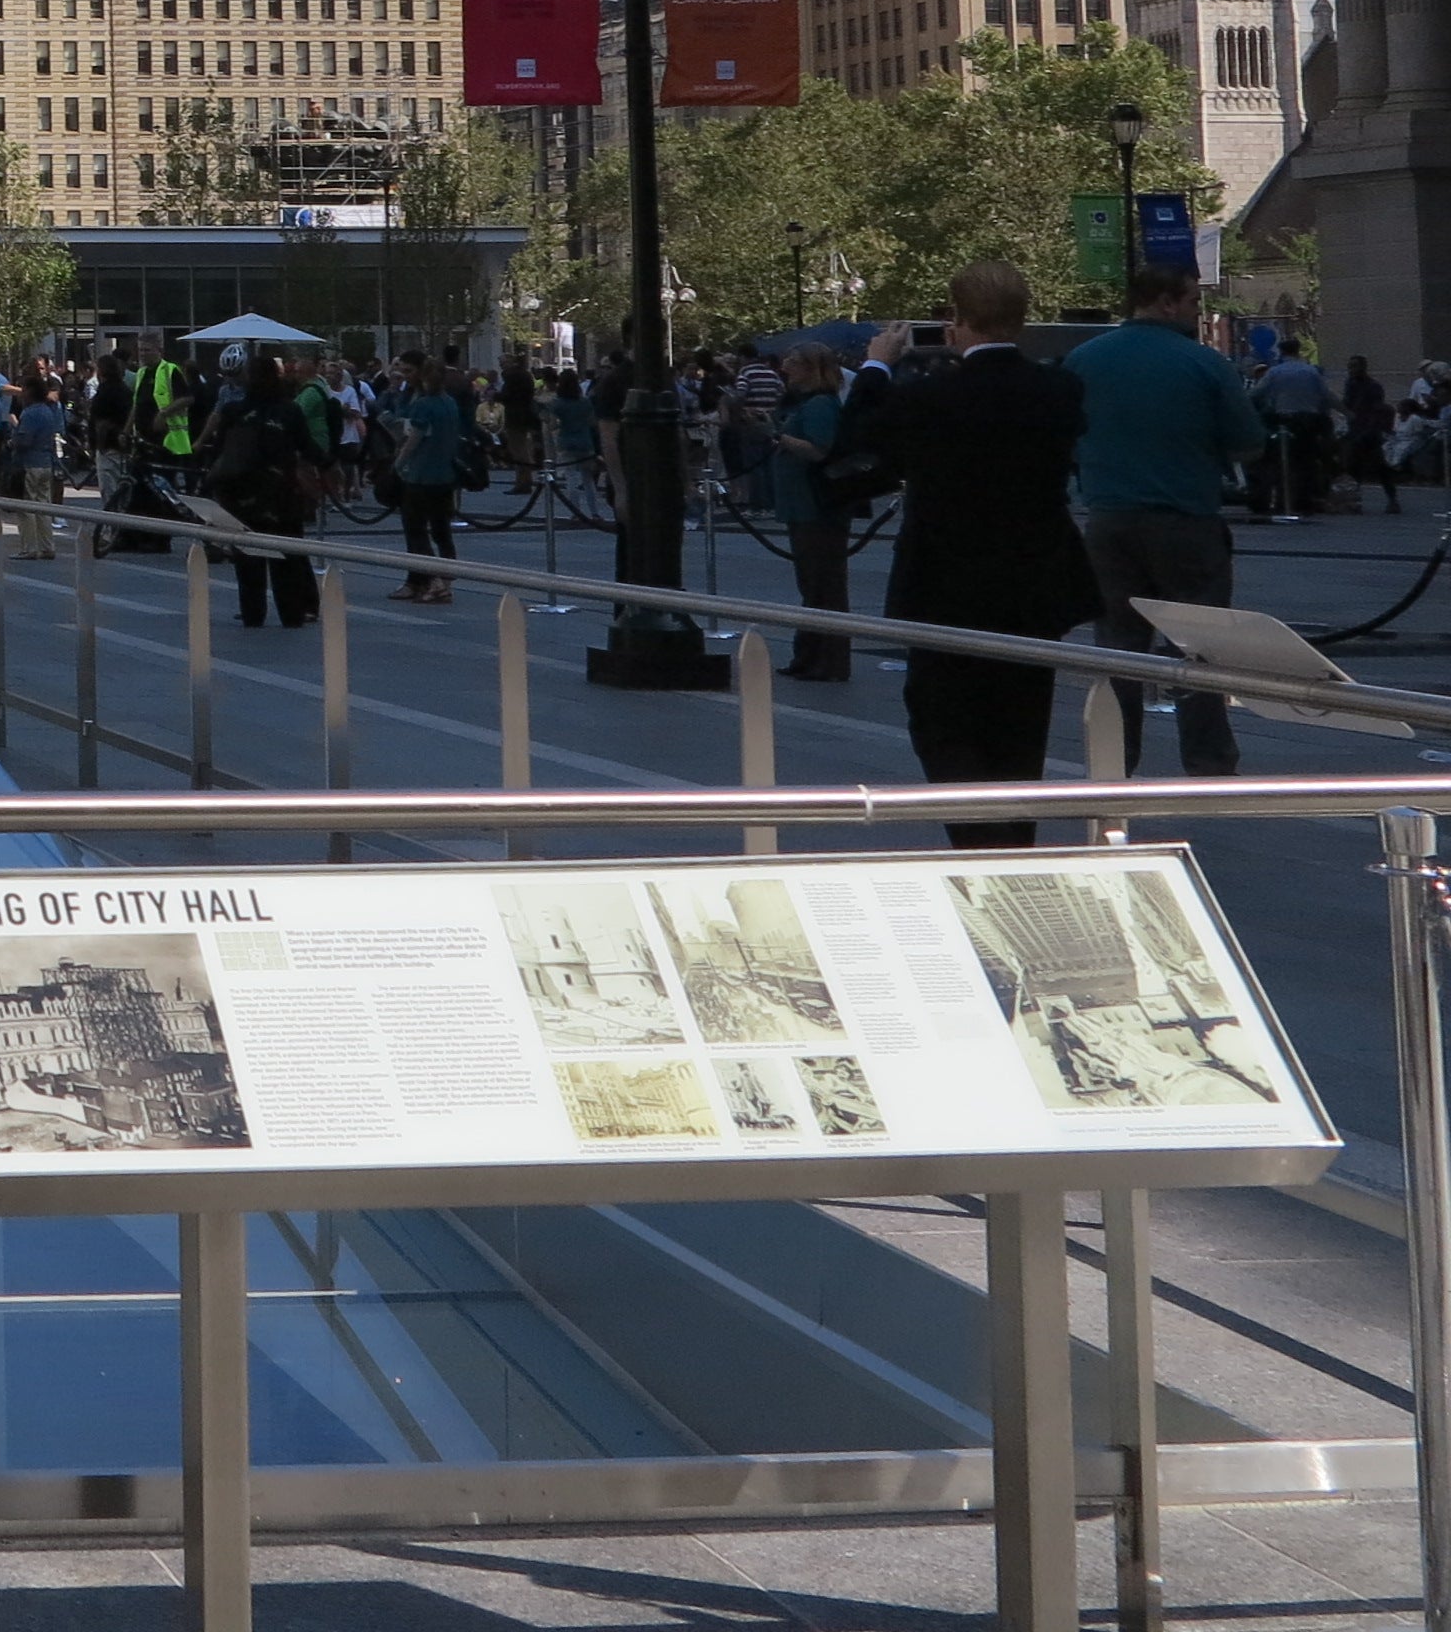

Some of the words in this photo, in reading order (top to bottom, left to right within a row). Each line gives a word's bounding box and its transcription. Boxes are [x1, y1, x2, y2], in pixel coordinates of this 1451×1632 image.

[38, 891, 81, 925] OF
[94, 890, 166, 924] CITY
[181, 888, 273, 922] HALL
